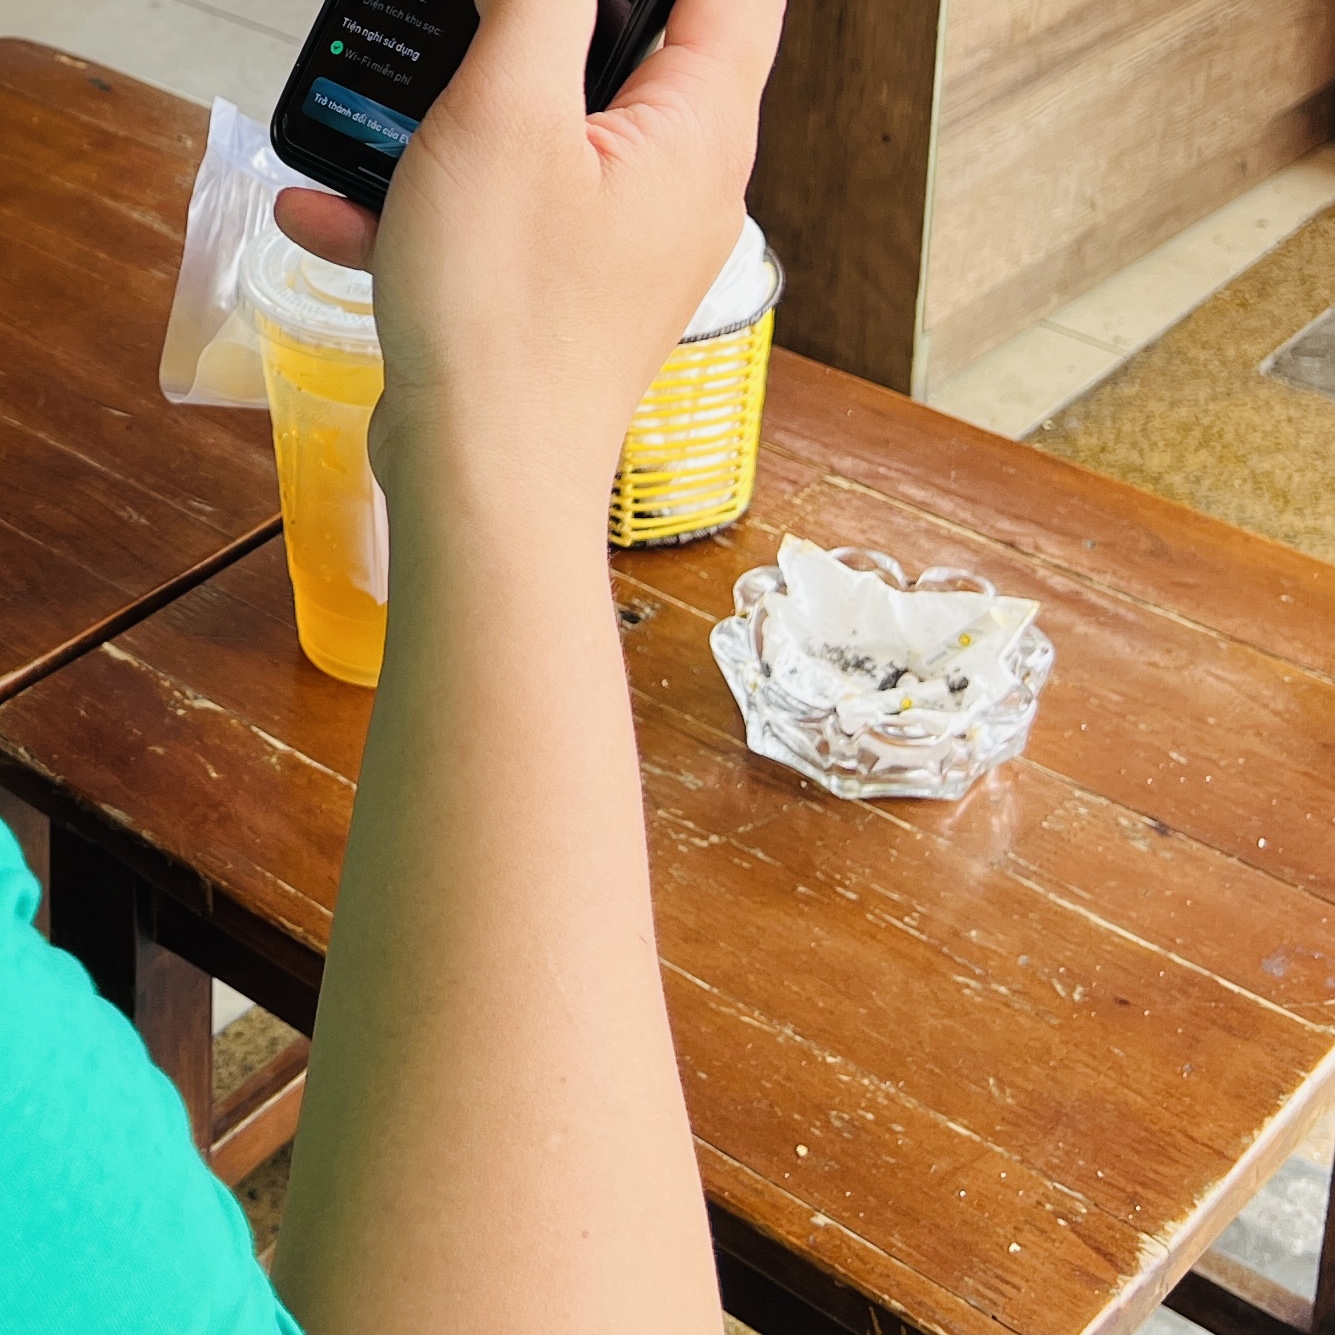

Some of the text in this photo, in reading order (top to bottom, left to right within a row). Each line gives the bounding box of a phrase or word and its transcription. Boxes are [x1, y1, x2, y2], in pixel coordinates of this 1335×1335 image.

[385, 5, 404, 19] tích
[404, 12, 422, 27] khu
[342, 16, 362, 34] Tiện
[382, 37, 397, 49] sử
[395, 42, 420, 62] dụng
[344, 48, 412, 85] Wi-Fi miễn phí
[314, 92, 328, 106] Trở
[327, 100, 352, 117] thành
[352, 112, 368, 125] đối
[366, 119, 382, 132] tác
[382, 127, 400, 140] của
